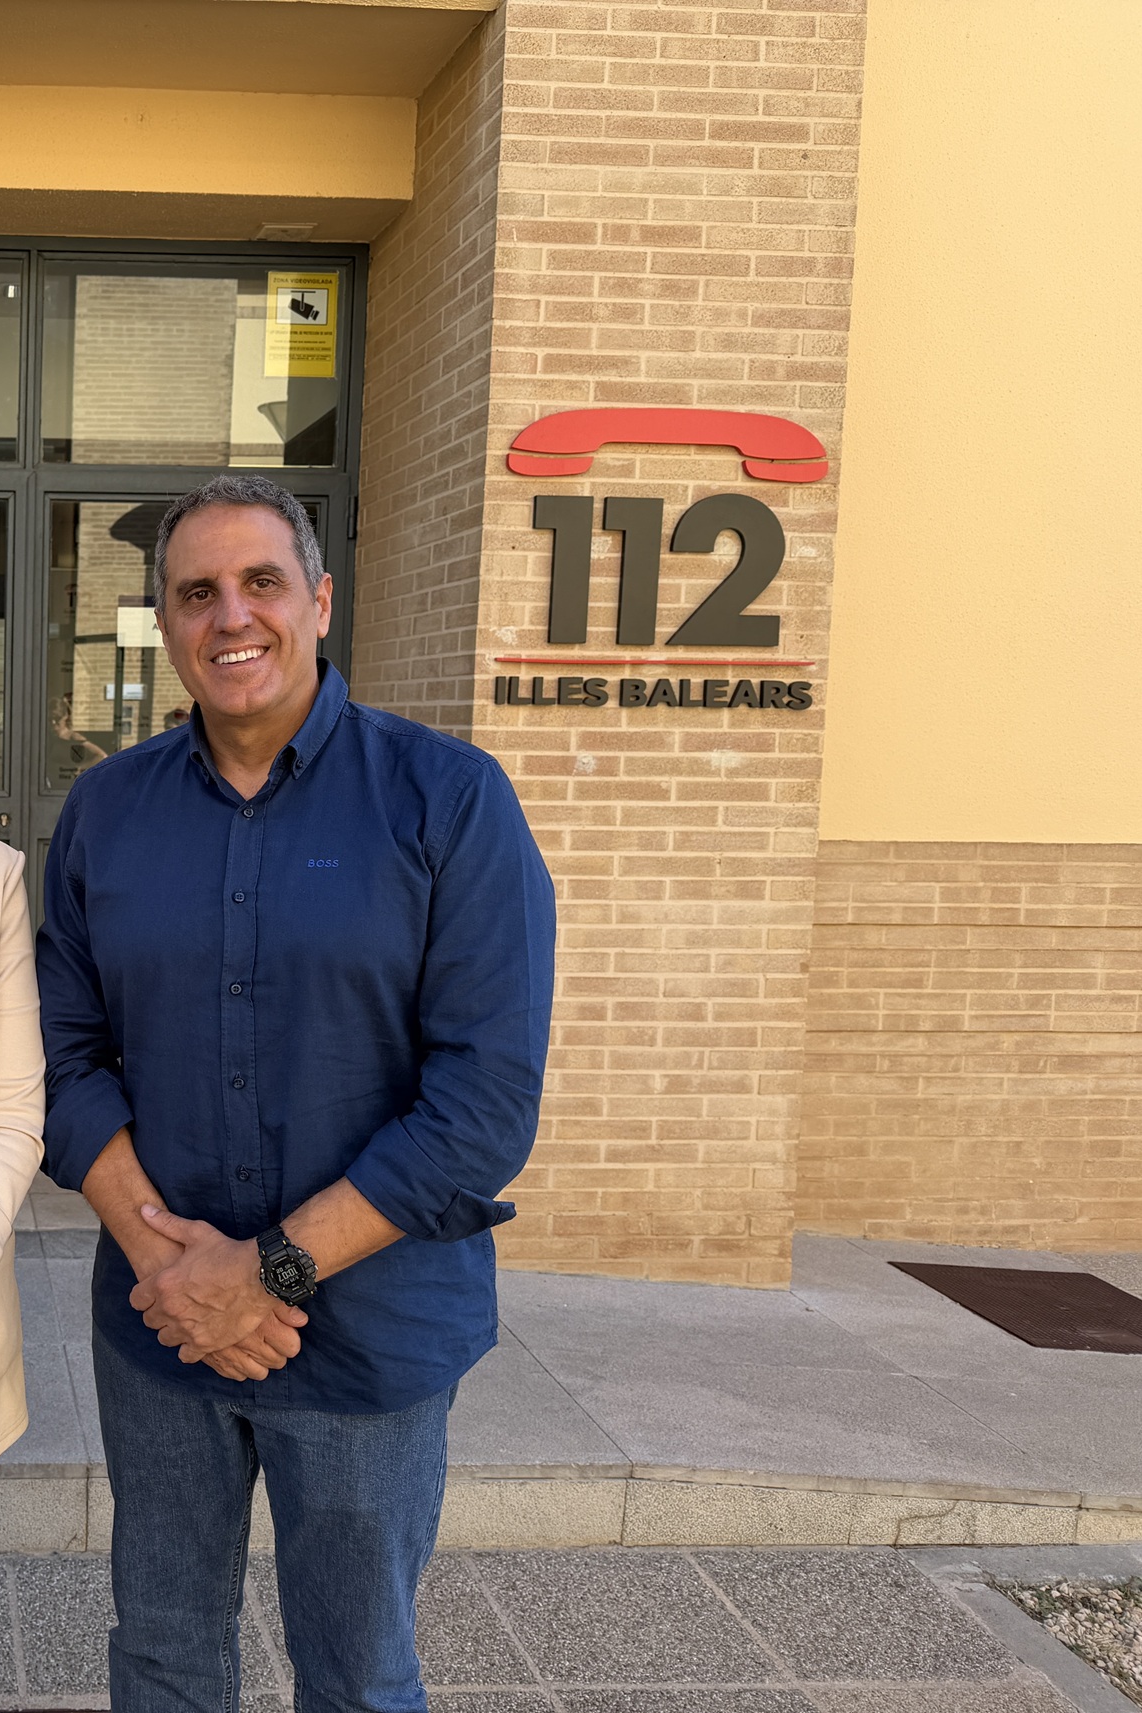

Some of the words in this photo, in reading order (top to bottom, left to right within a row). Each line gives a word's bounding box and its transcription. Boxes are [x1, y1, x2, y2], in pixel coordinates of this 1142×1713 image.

[533, 493, 786, 647] 112
[494, 676, 608, 707] ILLES
[619, 678, 814, 710] BALEARS
[308, 859, 339, 868] BOSS
